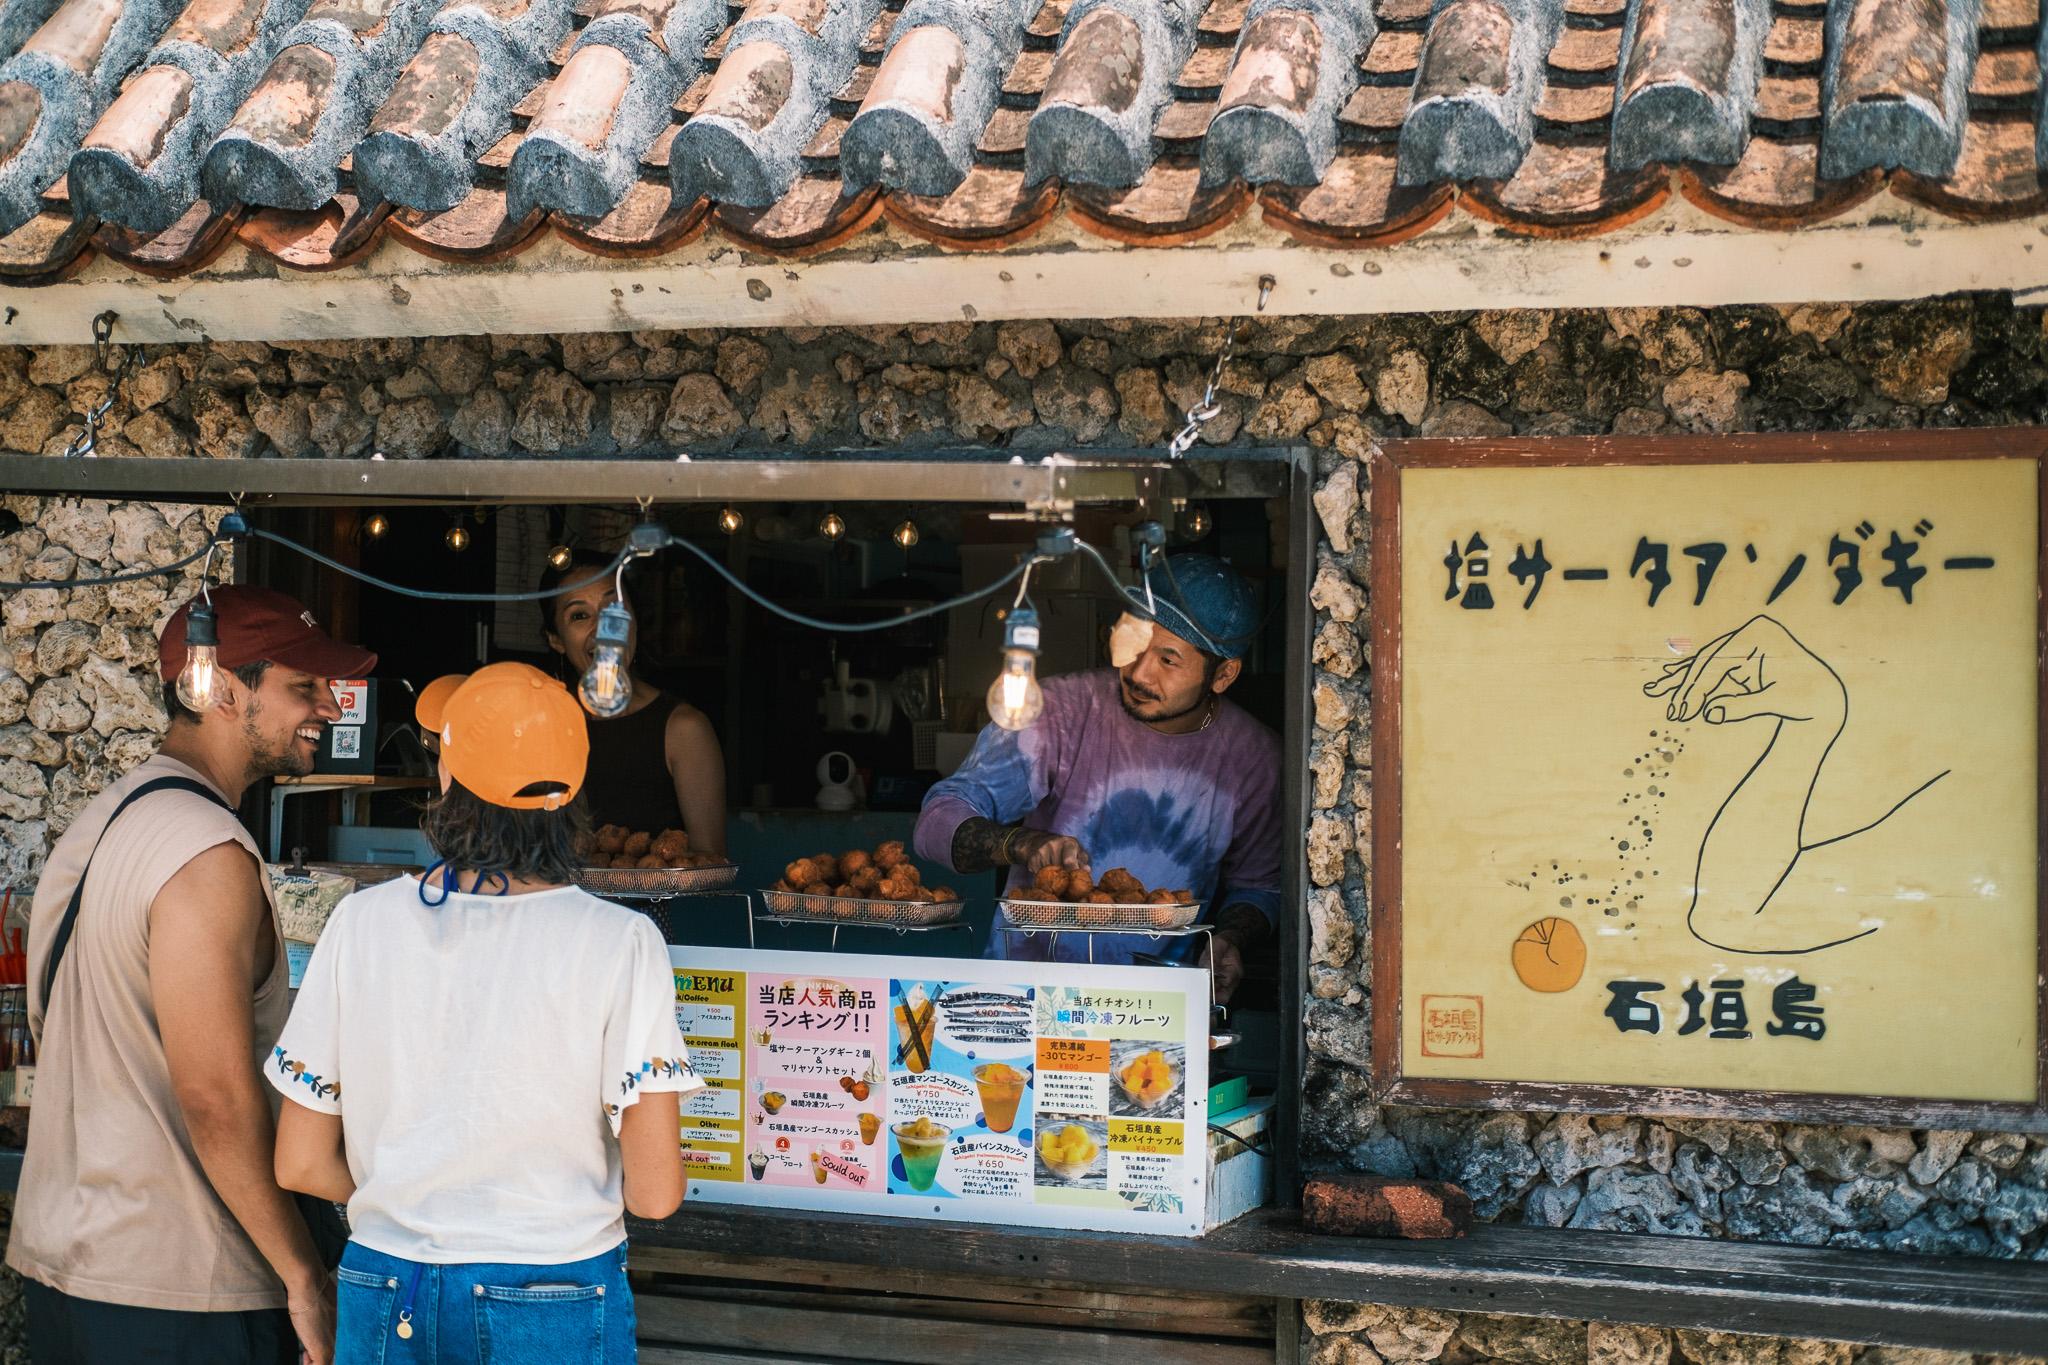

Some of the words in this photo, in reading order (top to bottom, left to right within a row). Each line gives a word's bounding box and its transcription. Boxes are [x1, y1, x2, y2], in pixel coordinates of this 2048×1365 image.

[1443, 519, 1995, 610] 塩サータアンダギー
[760, 985, 876, 1010] 当店人気商品
[1604, 975, 1826, 1042] 石垣島
[1056, 1010, 1170, 1028] 瞬間冷凍フルーツ
[781, 1064, 857, 1077] マリヤソフトセット
[802, 1091, 829, 1100] 石垣島産
[916, 1090, 940, 1098] ¥750
[790, 1099, 845, 1110] 瞬間冷凍フルーツ
[700, 1121, 720, 1129] Other
[768, 1123, 860, 1136] 石垣島産マンゴースカッシュ
[1126, 1123, 1162, 1134] 石垣島産
[1109, 1133, 1183, 1146] 冷凍パイナップル
[977, 1159, 1004, 1169] ¥650
